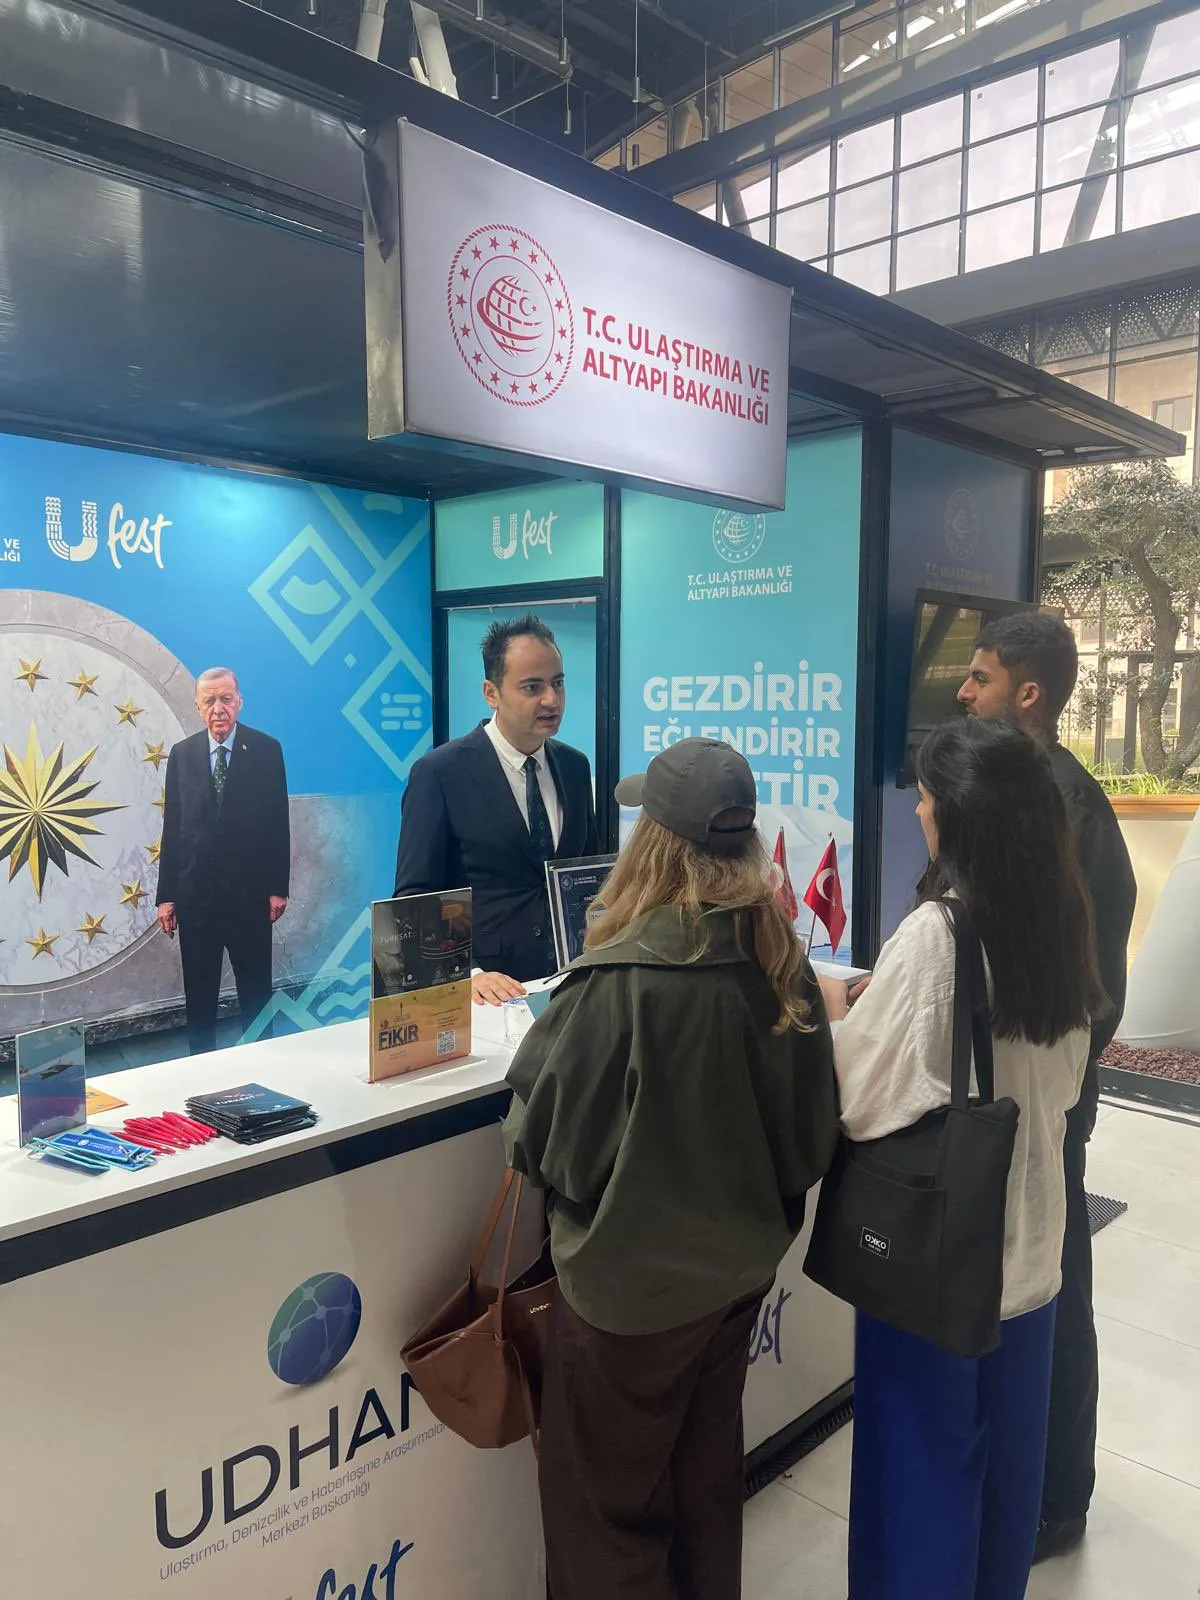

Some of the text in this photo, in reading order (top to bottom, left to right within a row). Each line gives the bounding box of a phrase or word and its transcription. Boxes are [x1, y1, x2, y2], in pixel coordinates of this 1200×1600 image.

[583, 307, 770, 393] T.C. ULAŞTIRMA VE
[583, 347, 769, 426] ALTYAPI BAKANLIĞI
[3, 538, 21, 550] VE
[107, 502, 173, 569] fest
[522, 509, 559, 560] fest
[687, 565, 793, 586] T.C. ULAŞTIRMA VE
[687, 579, 793, 601] ALTYAPI BAKANLIĞI
[643, 660, 843, 712] GEZDİRİR
[747, 1287, 792, 1365] est
[160, 1540, 228, 1580] Ulaştırma,
[232, 1504, 291, 1544] Denizcilik
[293, 1495, 309, 1511] ve
[311, 1458, 381, 1502] Haberleşme
[262, 1481, 370, 1547] Merkezi Başkanlığı
